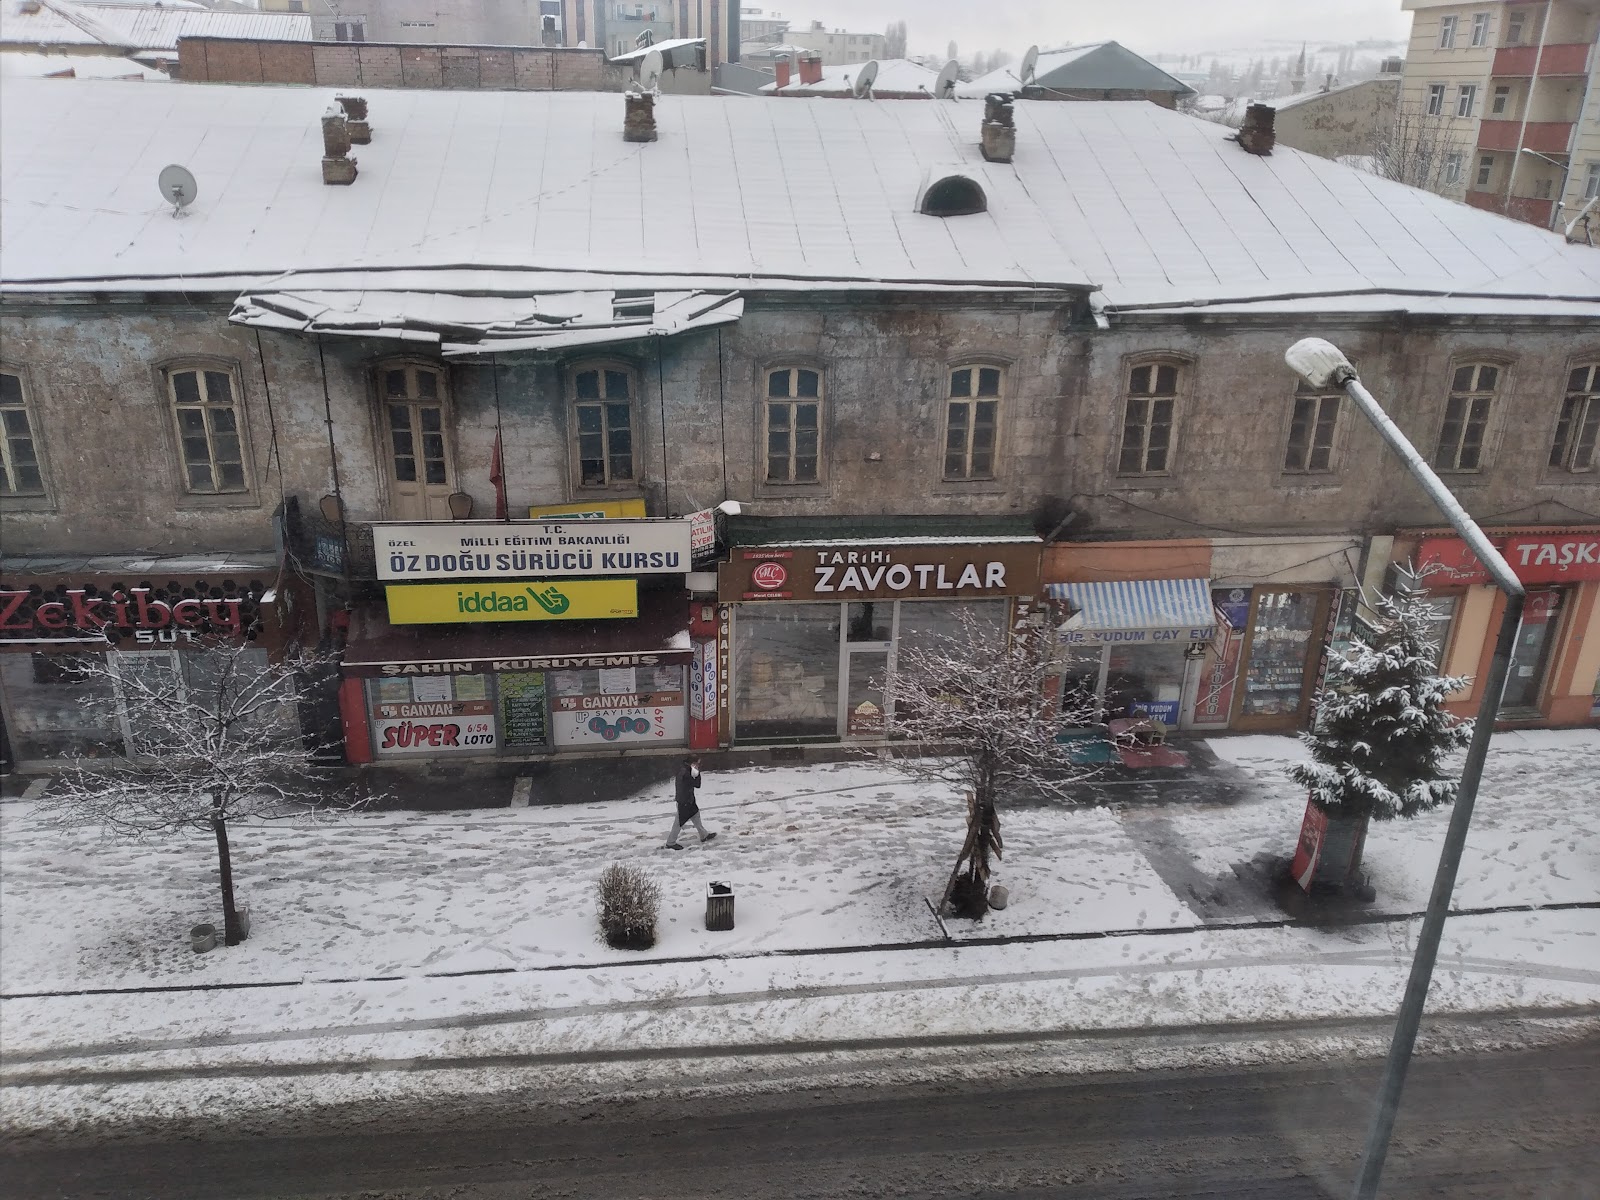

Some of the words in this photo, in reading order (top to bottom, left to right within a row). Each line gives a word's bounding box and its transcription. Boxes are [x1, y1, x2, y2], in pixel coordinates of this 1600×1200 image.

[542, 525, 567, 534] T.C.
[690, 525, 714, 537] ATILIK
[388, 539, 416, 547] ÖZEL
[559, 533, 630, 545] BAKANLIĞI
[390, 551, 421, 572] ÖZ
[425, 550, 491, 572] DOĞU
[496, 549, 593, 571] SÜRÜCÜ
[602, 551, 679, 569] KURSU
[814, 562, 1006, 591] ZAVOTLAR
[457, 591, 528, 613] iddaa
[1095, 631, 1145, 641] YUDUM
[582, 695, 639, 709] GANYAN
[401, 703, 453, 717] GANYAN
[595, 708, 648, 717] SAYISAL
[592, 719, 646, 739] LOTO
[655, 708, 665, 738] 6/49
[382, 720, 461, 749] SÜPER
[467, 723, 489, 733] 6/54
[464, 734, 495, 745] LOTO
